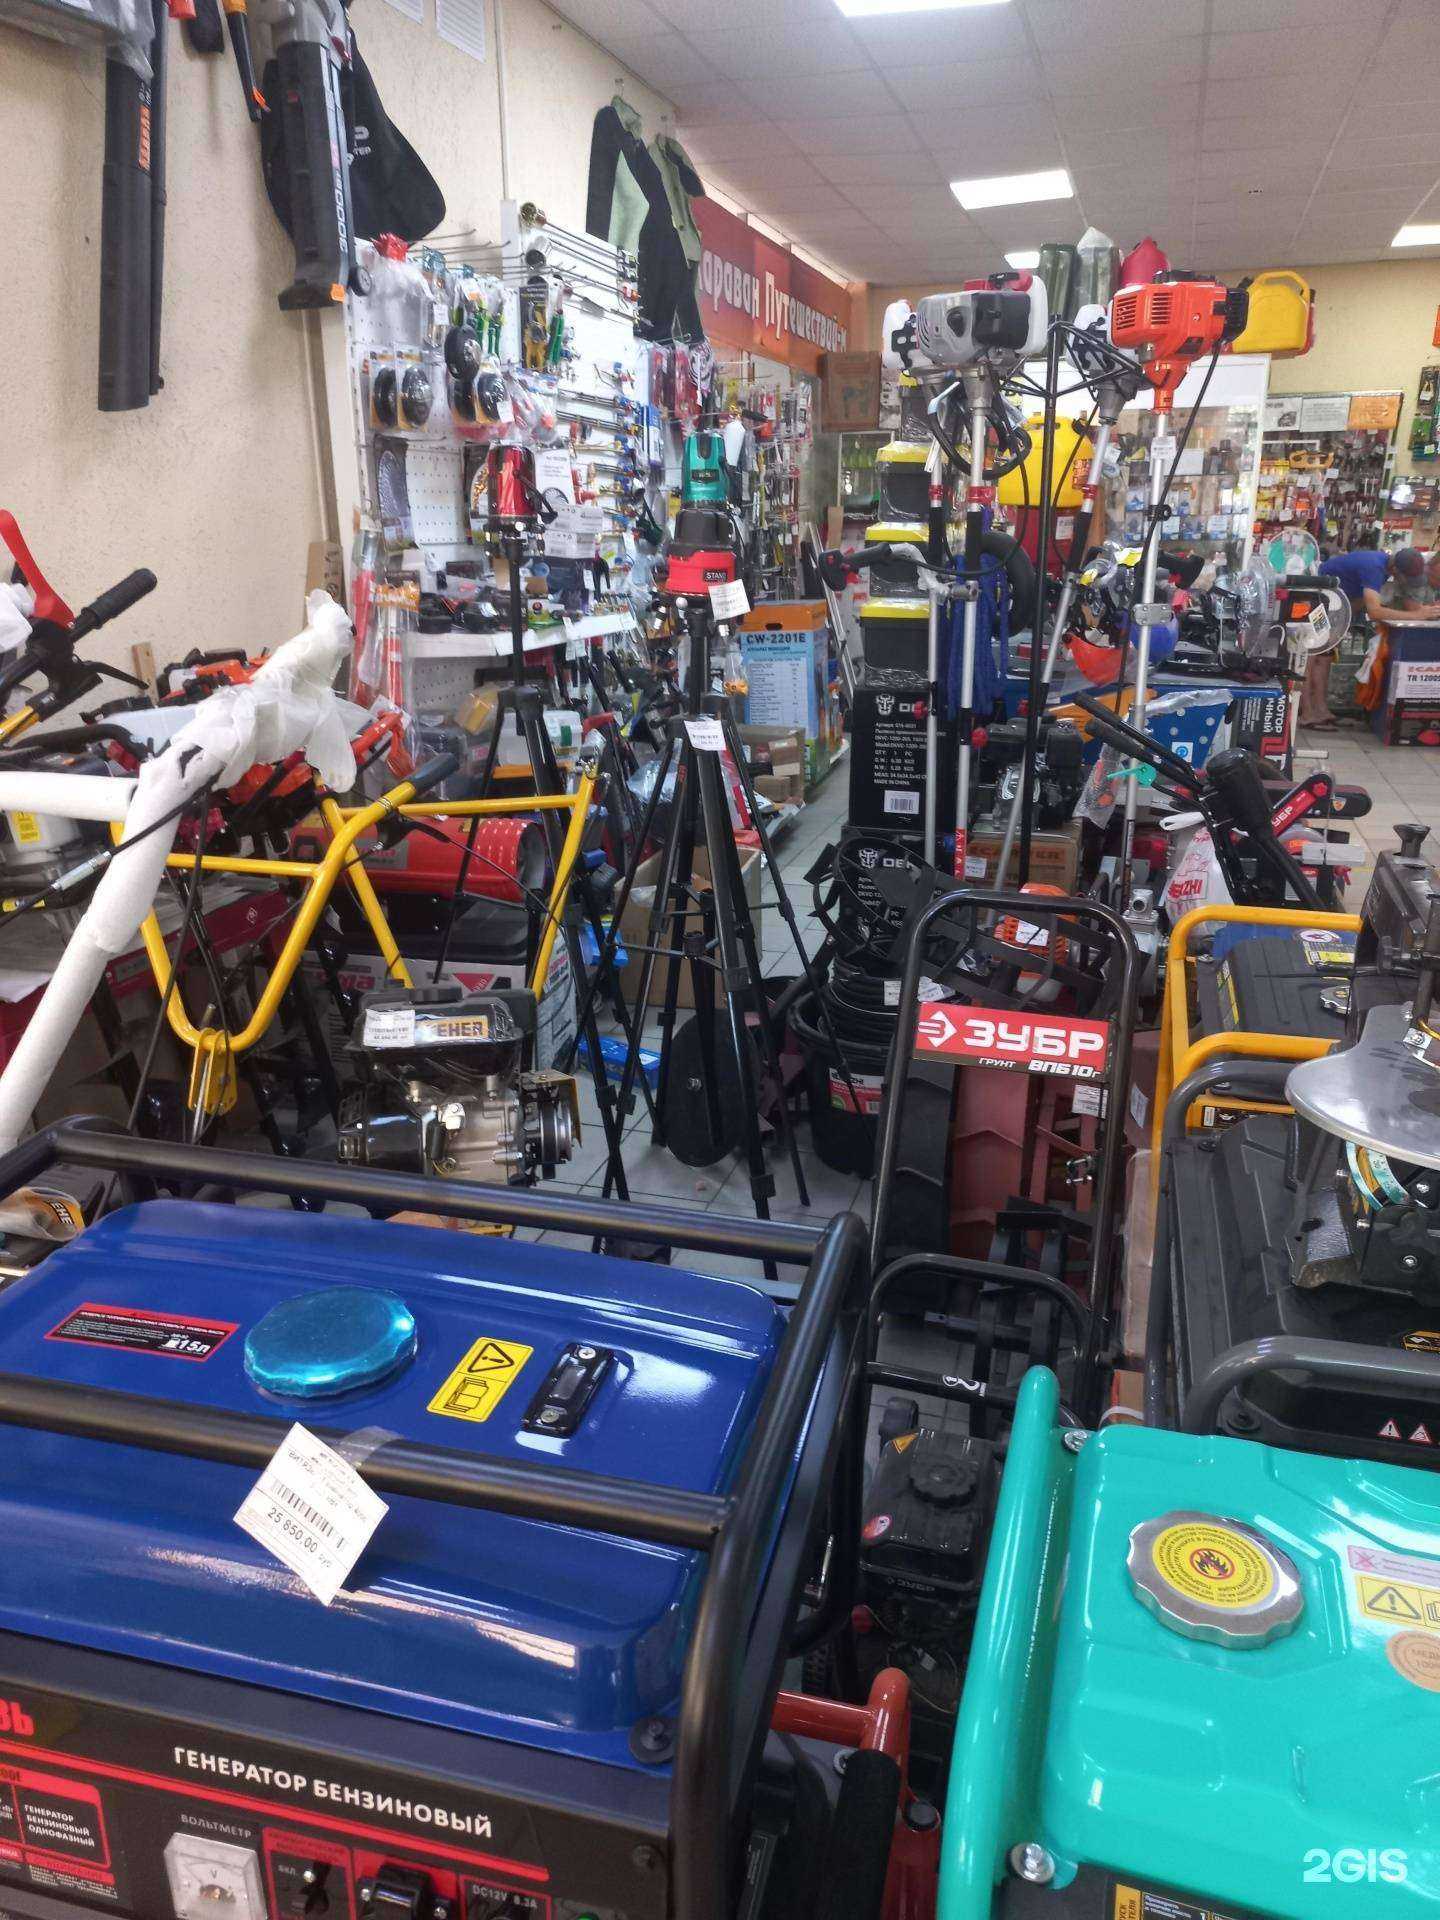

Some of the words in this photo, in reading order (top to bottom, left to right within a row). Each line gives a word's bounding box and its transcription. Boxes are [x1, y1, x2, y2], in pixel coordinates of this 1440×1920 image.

[746, 632, 807, 645] CW-2201E
[1270, 806, 1296, 828] УБР
[962, 1018, 1105, 1059] ЗУБР
[978, 1057, 1016, 1069] ГРУНТ
[267, 1507, 284, 1524] 25
[283, 1518, 319, 1554] 850,00
[173, 1746, 307, 1793] ГЕНЕРАТОР
[313, 1779, 493, 1839] БЕНЗИНОВЫЙ
[24, 1804, 74, 1822] ГЕНЕРАТОР
[26, 1814, 91, 1836] БЕНЗИНОВЫЙ
[28, 1824, 95, 1848] ОДНОФАЗНЫЙ
[180, 1814, 252, 1839] ВОЛЬТМЕТР
[472, 1884, 508, 1902] DC12V
